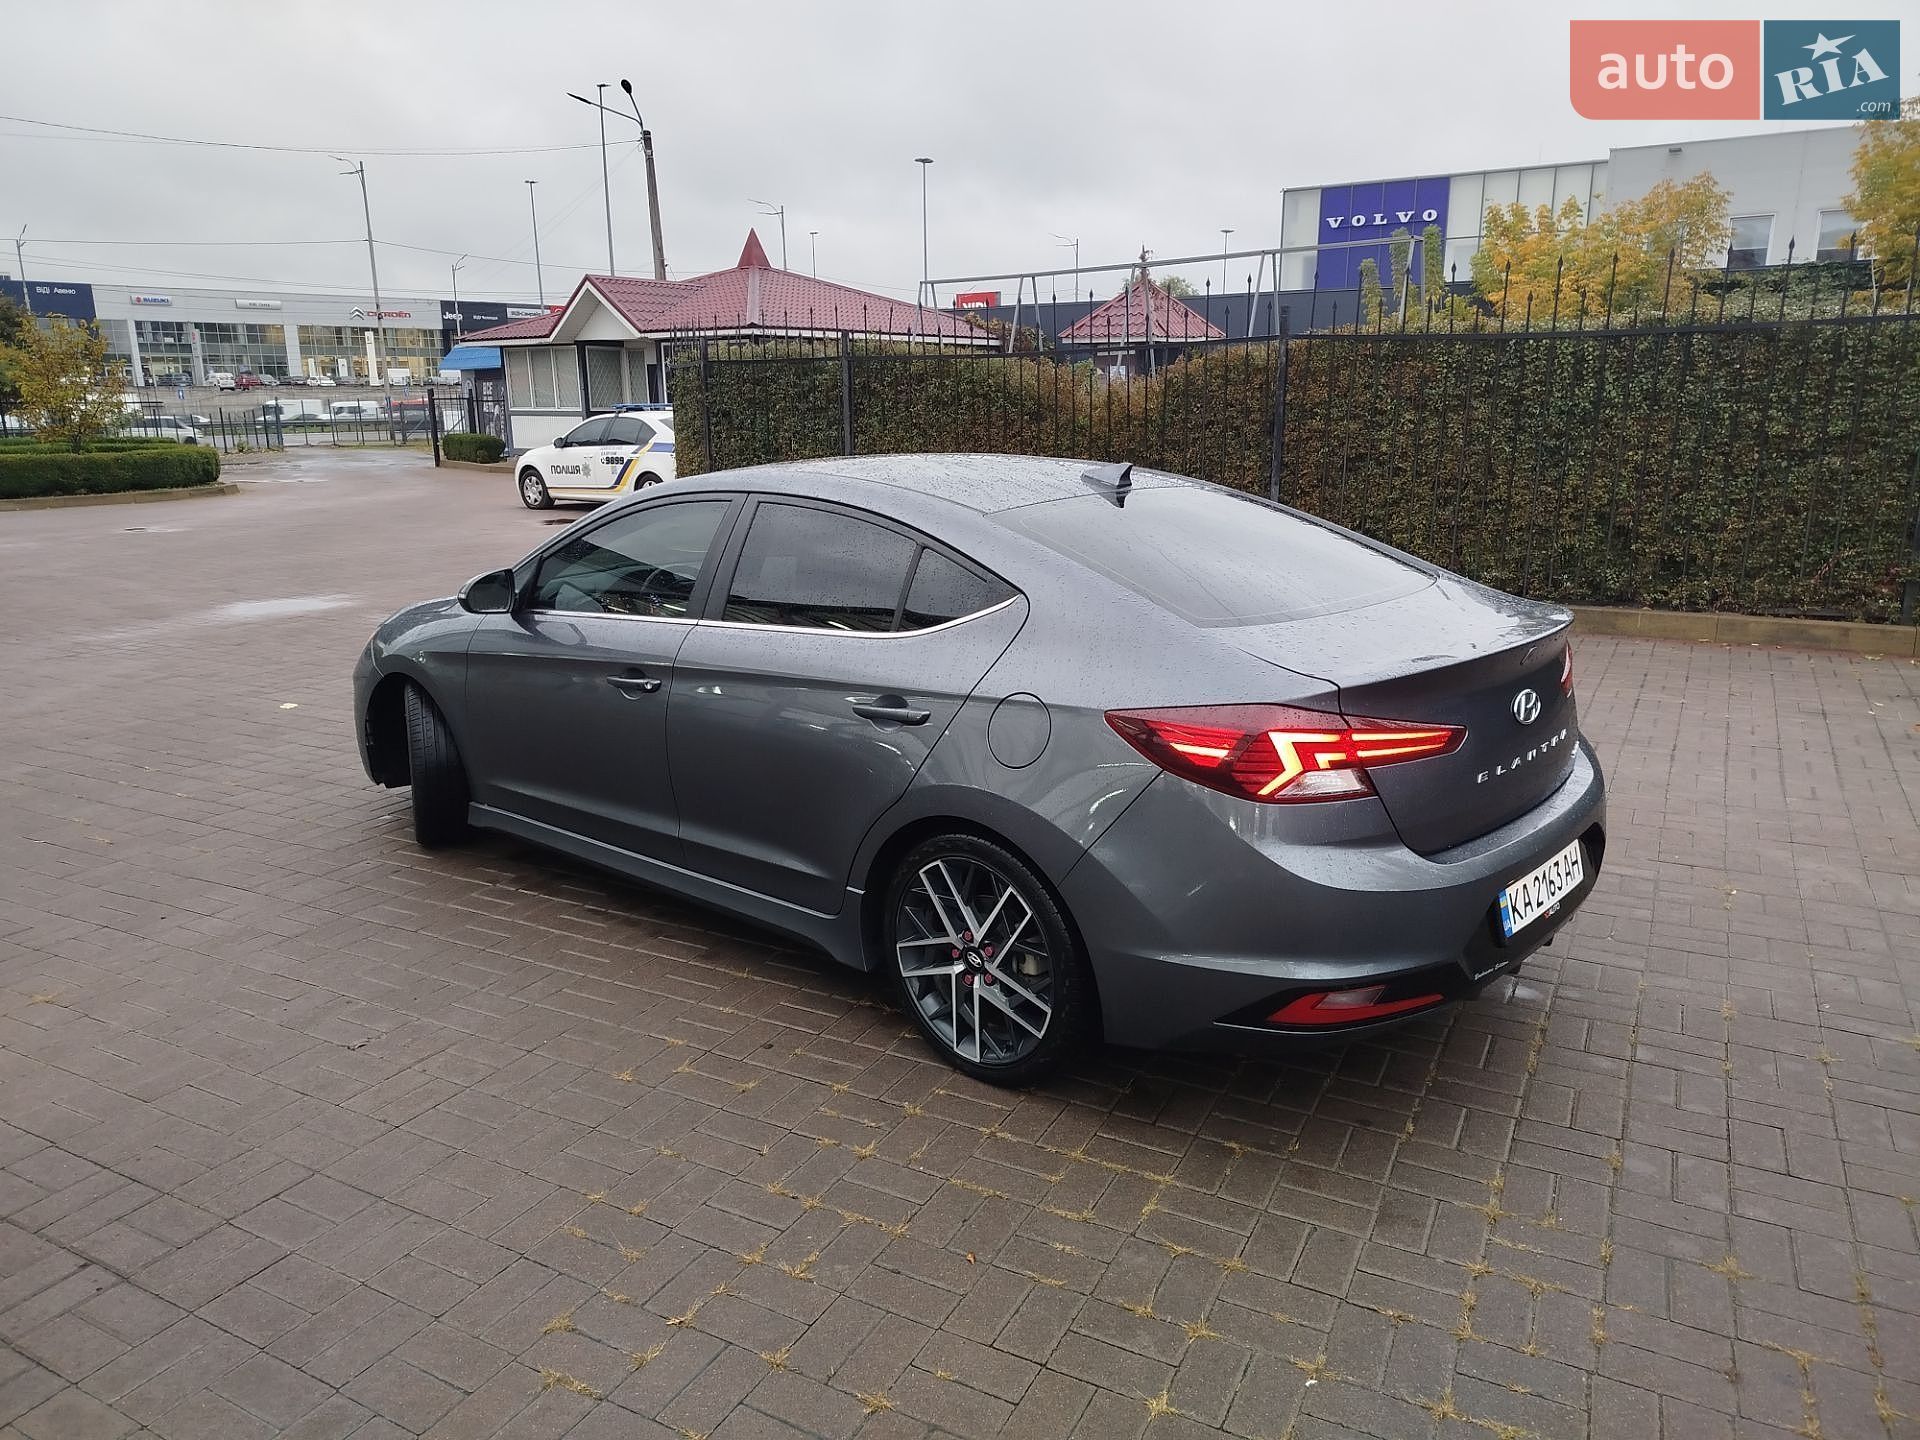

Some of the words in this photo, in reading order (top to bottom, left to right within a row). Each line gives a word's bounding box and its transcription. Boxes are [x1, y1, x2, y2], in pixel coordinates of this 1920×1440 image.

[1326, 209, 1438, 229] VOLVO
[550, 464, 581, 476] ПОЛІЦІЯ
[1509, 883, 1534, 925] KA
[1533, 860, 1563, 909] 2163
[1564, 846, 1581, 887] AH
